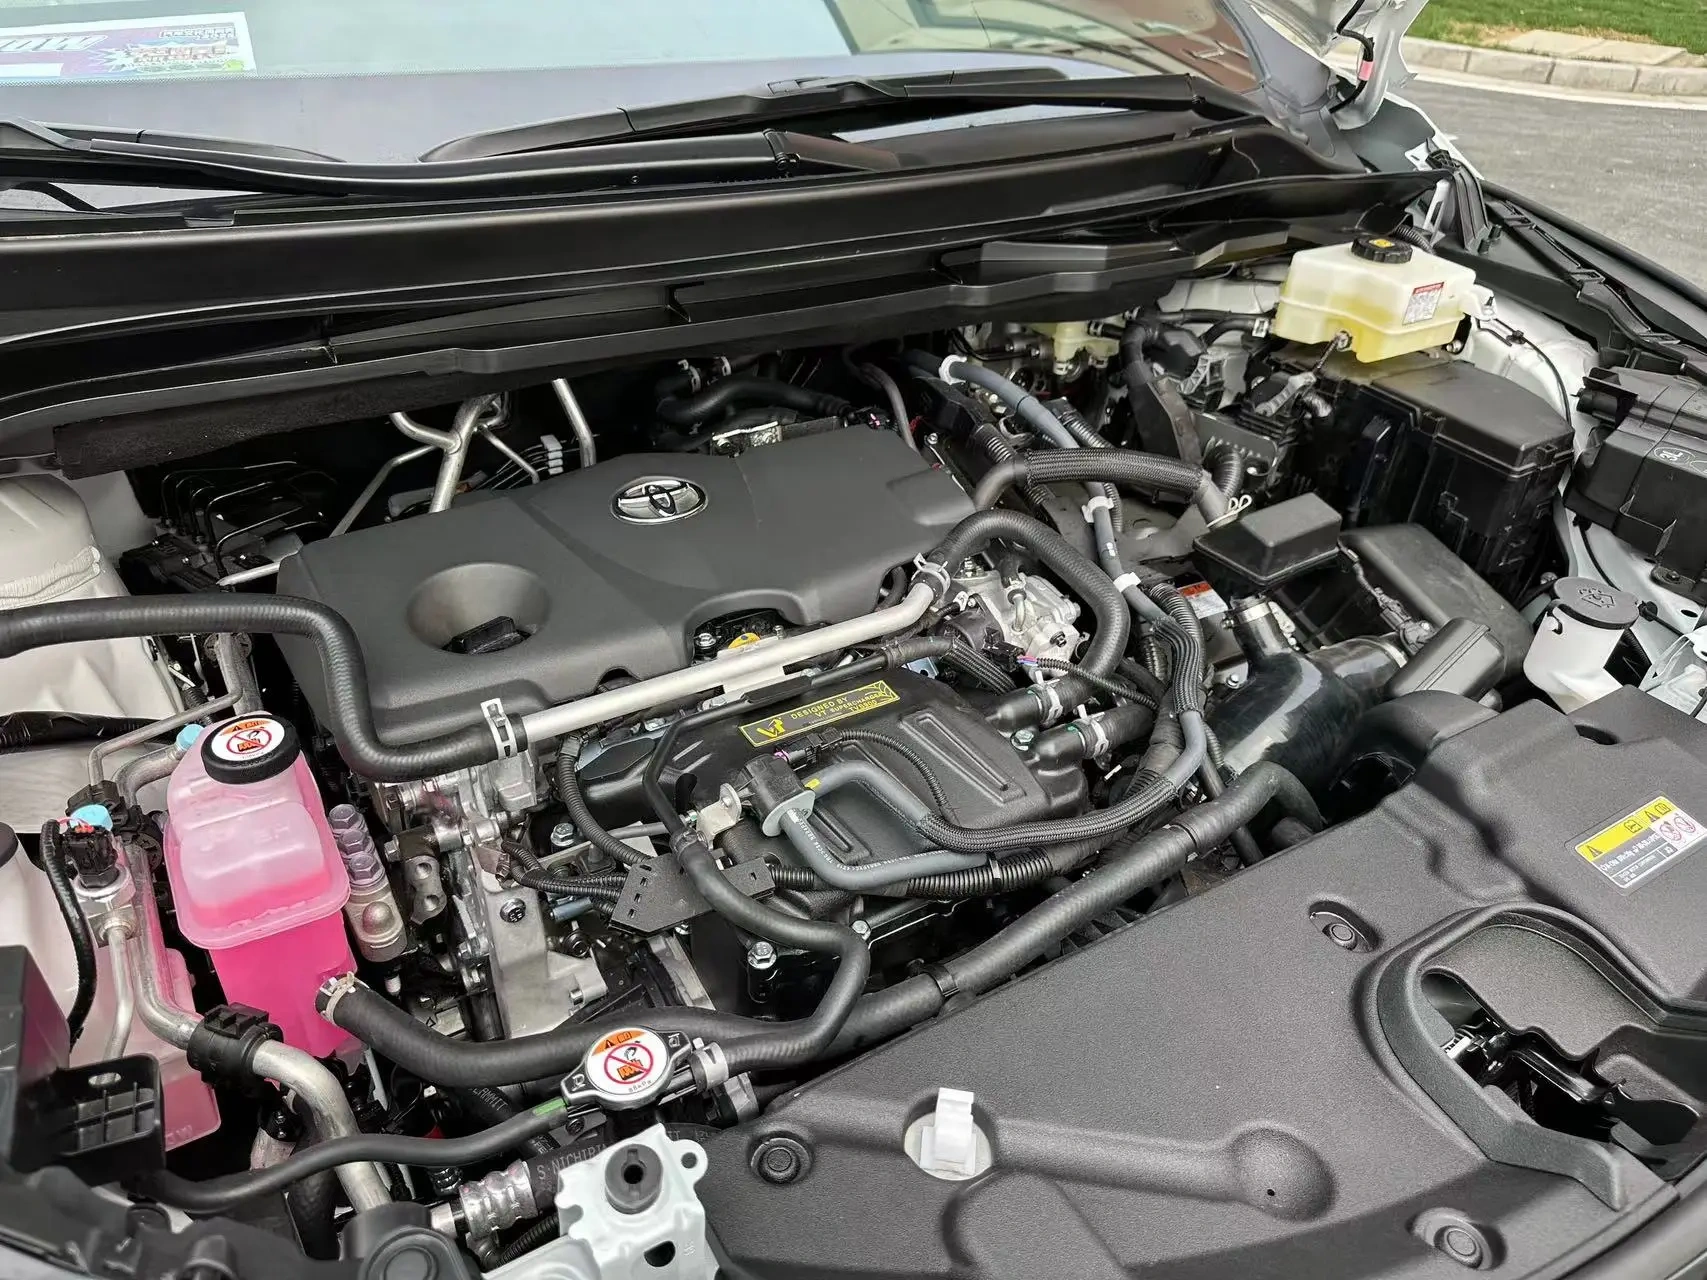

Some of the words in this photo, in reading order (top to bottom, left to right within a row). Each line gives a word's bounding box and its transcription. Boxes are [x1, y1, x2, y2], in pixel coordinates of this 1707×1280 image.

[790, 701, 835, 720] DESIGNED
[836, 696, 848, 705] BY
[815, 710, 827, 718] VT
